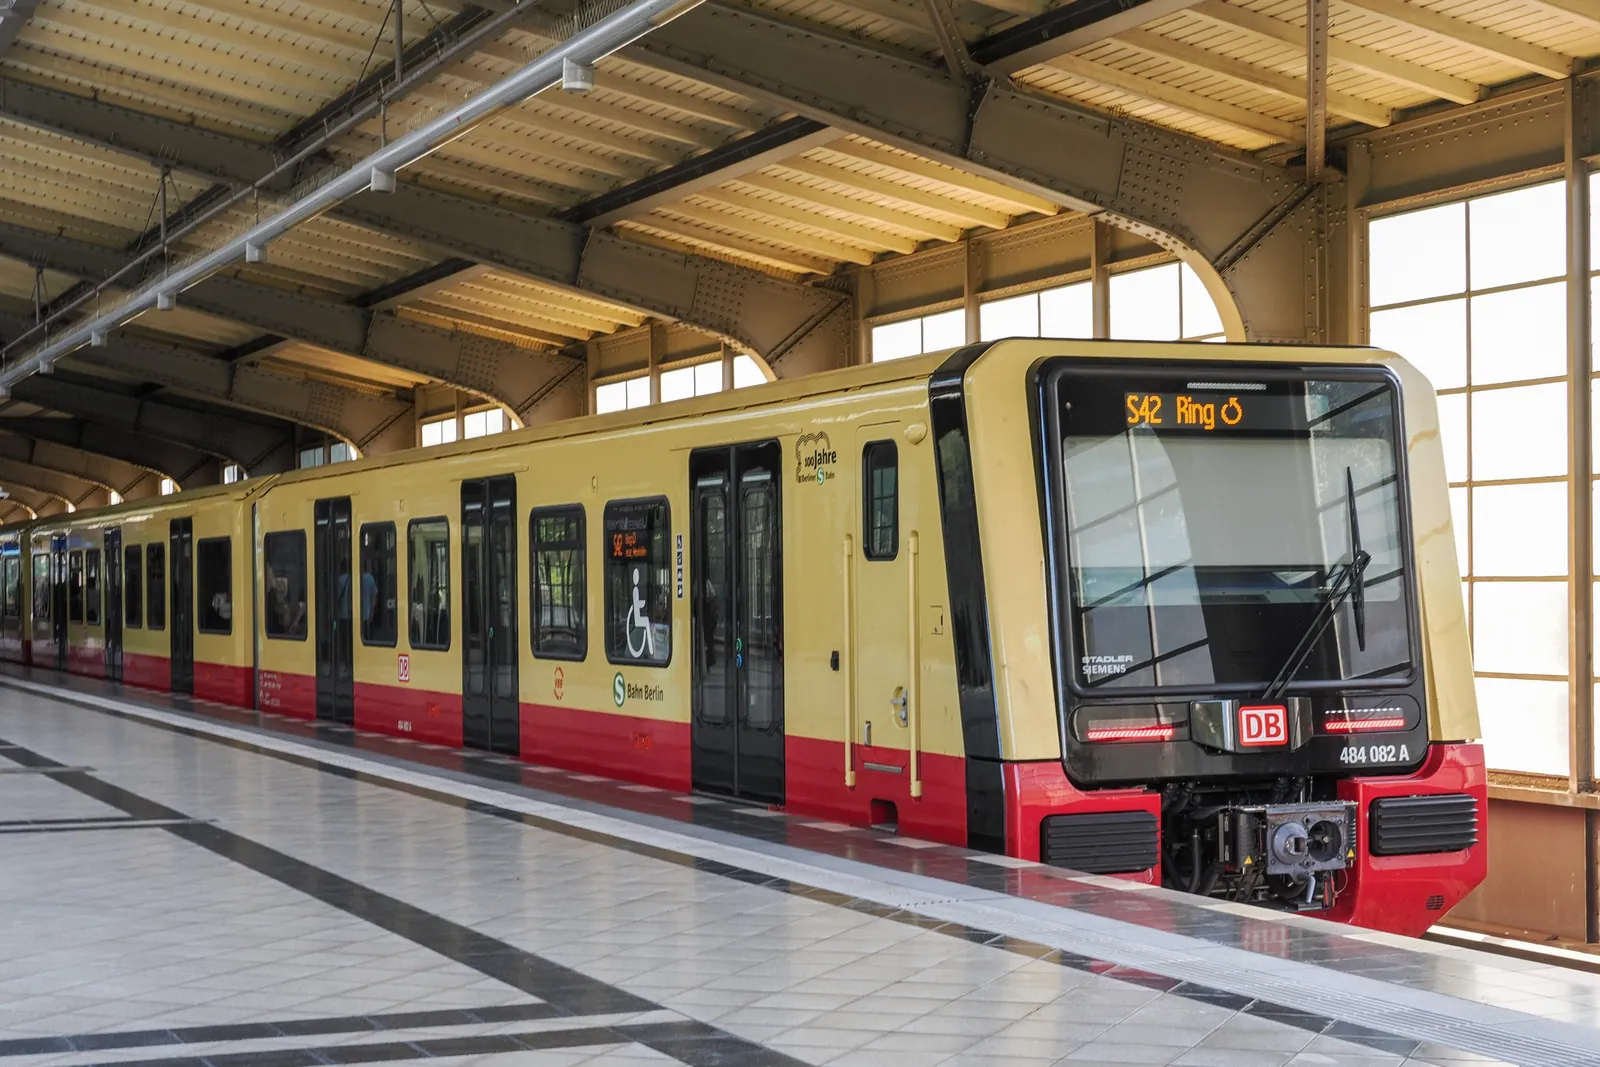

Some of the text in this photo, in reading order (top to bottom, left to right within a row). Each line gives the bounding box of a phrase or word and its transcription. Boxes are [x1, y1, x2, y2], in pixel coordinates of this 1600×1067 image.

[1126, 395, 1215, 430] S42 Ring
[399, 658, 409, 678] DB
[1082, 655, 1133, 663] STADLER
[1082, 664, 1127, 674] SIEMENS
[613, 672, 664, 708] S Bahn Berlin
[1244, 712, 1283, 740] DB
[1339, 744, 1410, 764] 484 082 A
